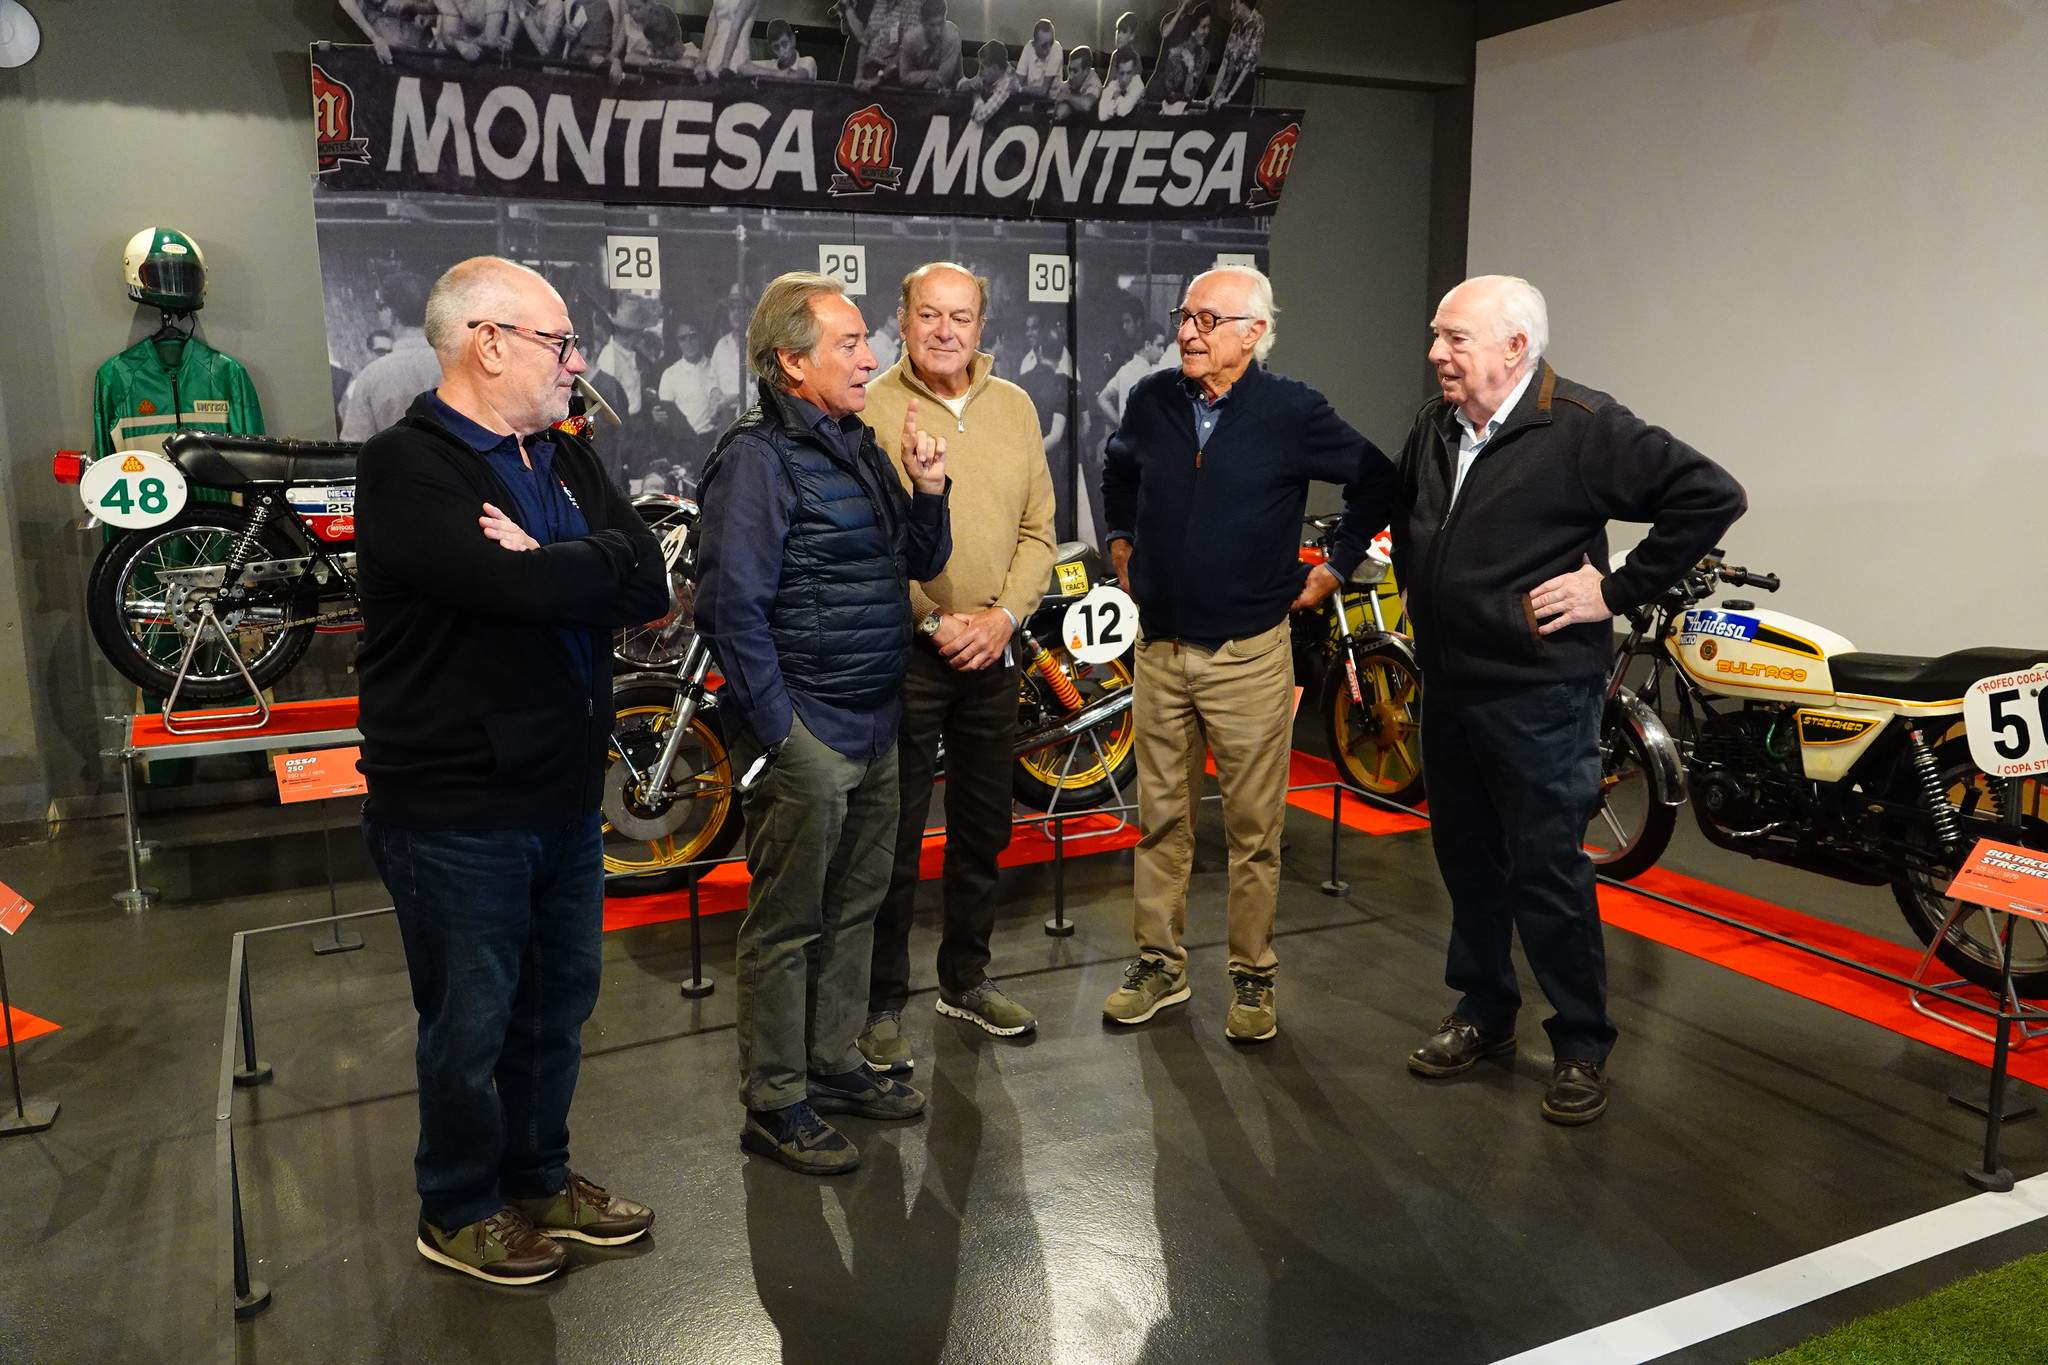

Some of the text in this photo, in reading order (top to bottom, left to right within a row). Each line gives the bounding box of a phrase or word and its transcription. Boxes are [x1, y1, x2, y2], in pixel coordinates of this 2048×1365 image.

[386, 77, 817, 191] MONTESA
[905, 115, 1247, 207] MONTESA
[615, 246, 653, 278] 28
[826, 254, 858, 284] 29
[1036, 263, 1065, 291] 30
[100, 477, 168, 514] 48
[327, 490, 355, 498] NECT
[1065, 582, 1085, 591] CRAC'S
[1078, 602, 1122, 646] 12
[1345, 663, 1360, 700] MOTUL
[1716, 660, 1807, 682] BULTACO
[1977, 677, 2014, 694] TROFEO
[1803, 716, 1863, 731] STREAKER
[285, 757, 317, 766] OSSA
[286, 765, 304, 773] 250
[2004, 763, 2031, 775] COPA
[1984, 848, 2048, 870] BULTACO
